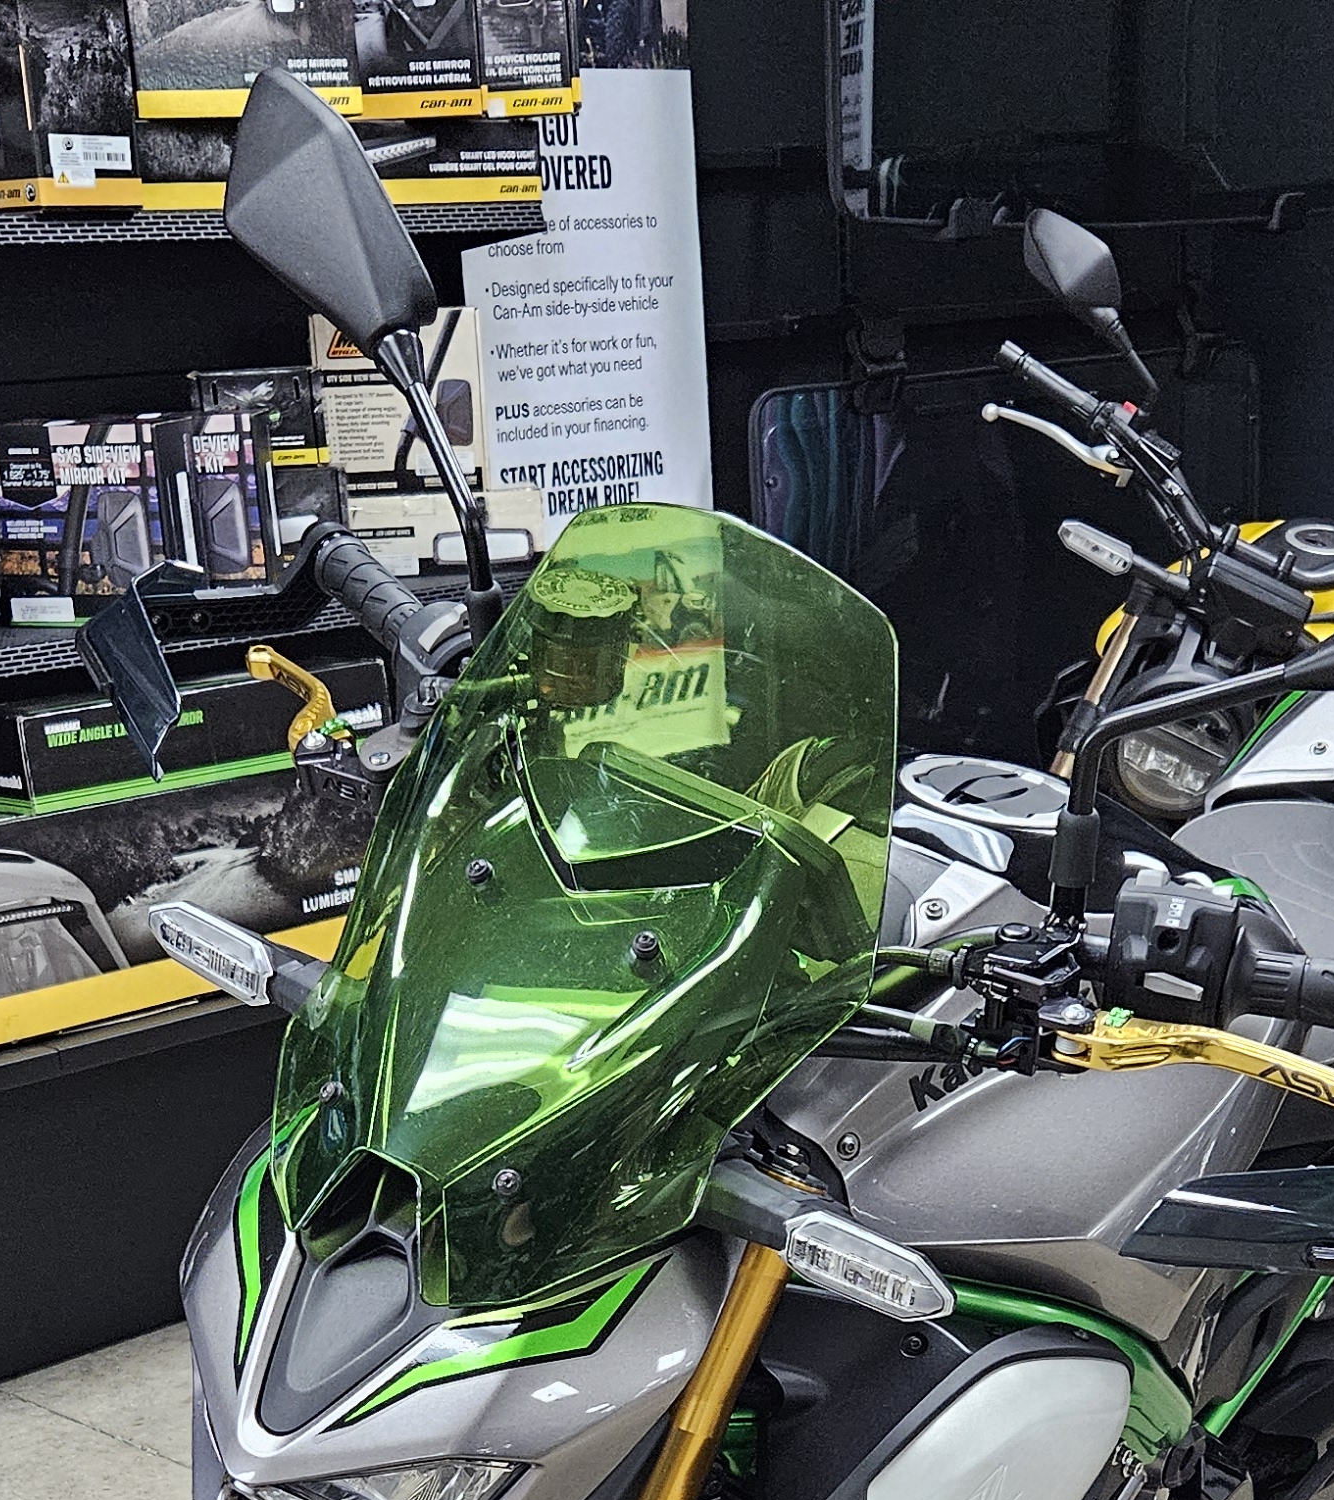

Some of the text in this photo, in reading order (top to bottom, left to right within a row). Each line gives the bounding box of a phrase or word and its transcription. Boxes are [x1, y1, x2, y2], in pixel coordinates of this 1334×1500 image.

[287, 58, 348, 68] SIDE MIRRORS
[409, 61, 433, 72] SIDE
[435, 59, 471, 71] MIRROR
[494, 54, 525, 65] DEVICE
[525, 52, 561, 63] HOLDER
[368, 74, 432, 87] RÉTROVISEUR
[433, 72, 472, 85] LATÉRAL
[498, 63, 562, 77] ÉLECTRONIQUE
[544, 73, 562, 83] LITE
[420, 97, 473, 110] can-am
[513, 97, 563, 108] can-am
[541, 155, 612, 191] OVERED
[499, 184, 538, 194] can-am
[559, 216, 570, 231] of
[573, 214, 644, 231] accessories
[646, 215, 657, 229] to
[488, 239, 565, 258] choose from
[491, 273, 674, 299] Designed specifically to fit your
[493, 295, 659, 321] Can-Am side-by-side vehicle
[495, 333, 657, 360] Whether it's for work or fun,
[498, 356, 643, 382] we've got what you need
[495, 393, 644, 421] PLUS accessories can be
[497, 415, 650, 443] included in your financing.
[192, 434, 240, 453] DEVIEW
[84, 444, 142, 463] SIDEVIEW
[204, 455, 225, 473] KIT
[500, 463, 546, 489] START
[552, 450, 664, 488] ACCESSORIZING
[59, 465, 127, 485] MIRROR KIT
[547, 486, 598, 517] DREAM
[46, 730, 78, 748] WIDE
[79, 725, 113, 743] ANGLE
